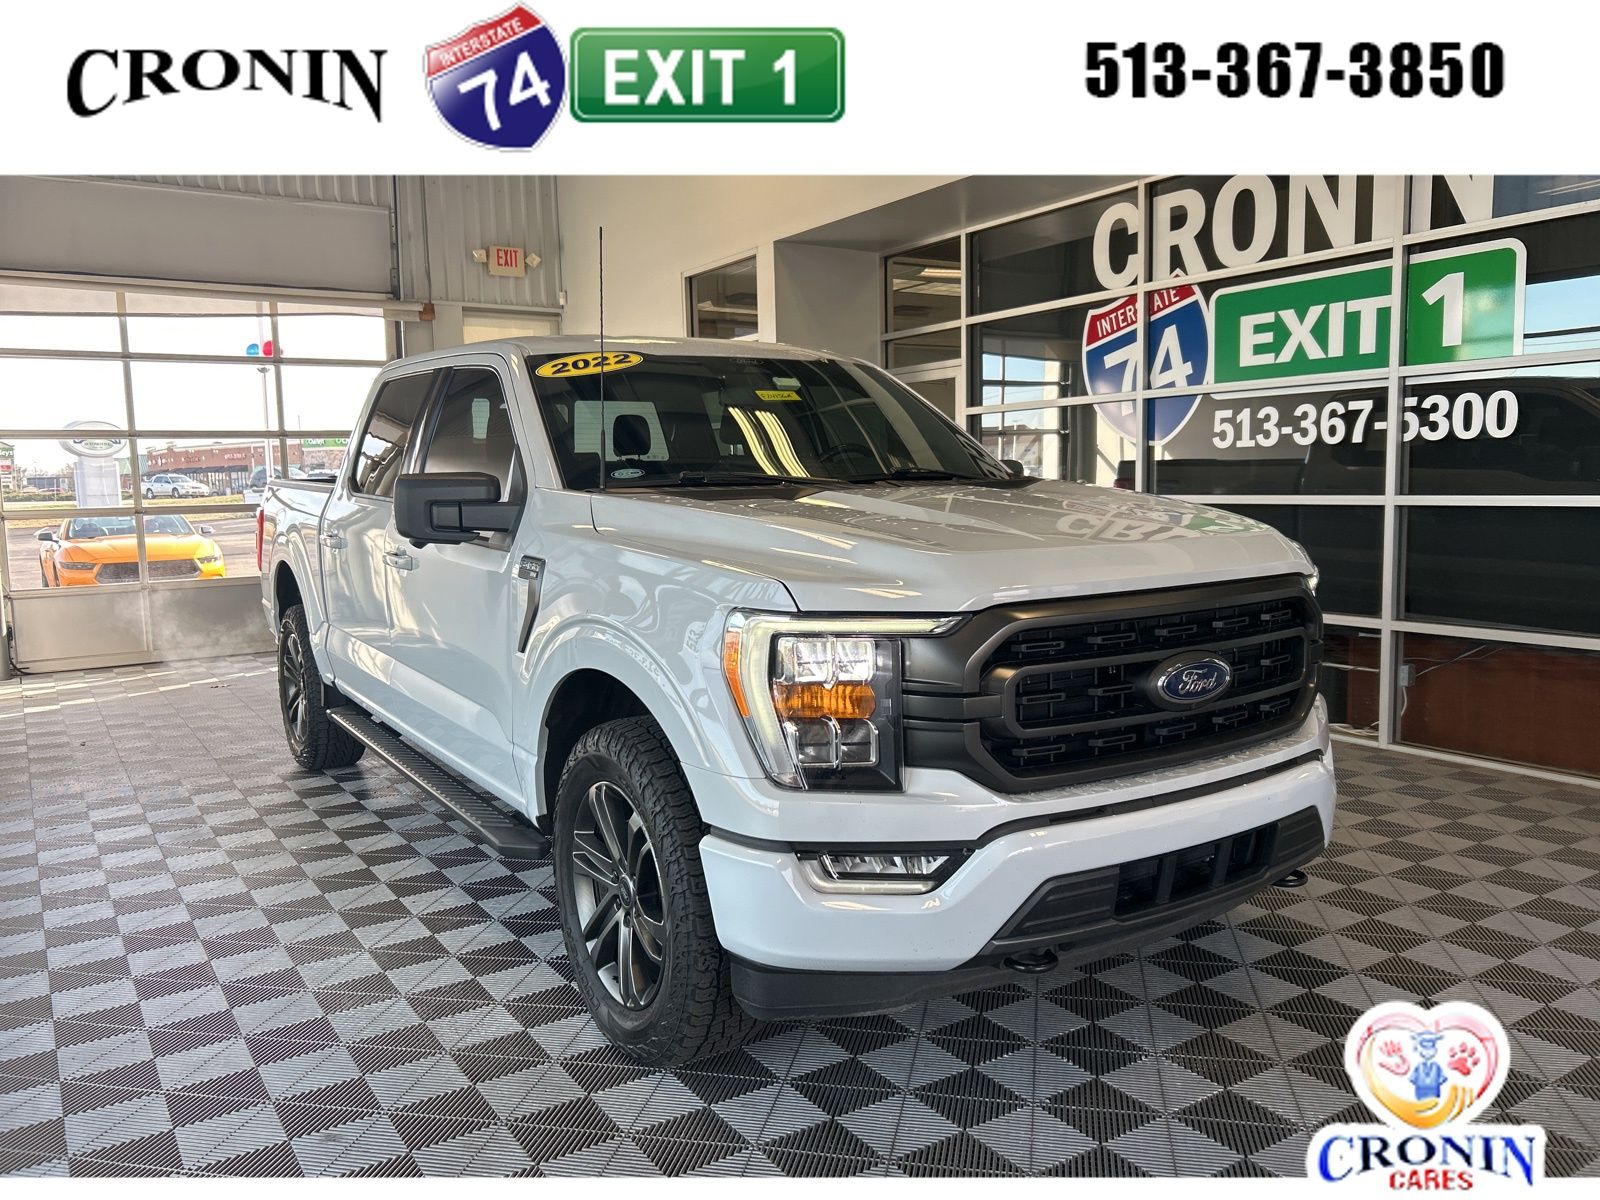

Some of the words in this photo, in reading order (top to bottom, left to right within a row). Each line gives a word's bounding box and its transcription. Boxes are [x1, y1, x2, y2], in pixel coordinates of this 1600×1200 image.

[496, 248, 519, 268] EXIT
[1093, 175, 1495, 289] CRONIN
[1096, 287, 1181, 338] INTERATE
[1239, 295, 1393, 368] EXIT
[1421, 271, 1465, 347] 1
[550, 353, 632, 376] 2022
[1103, 323, 1194, 417] 74
[1211, 390, 1519, 449] 513-367-5300
[1179, 667, 1218, 695] Ford
